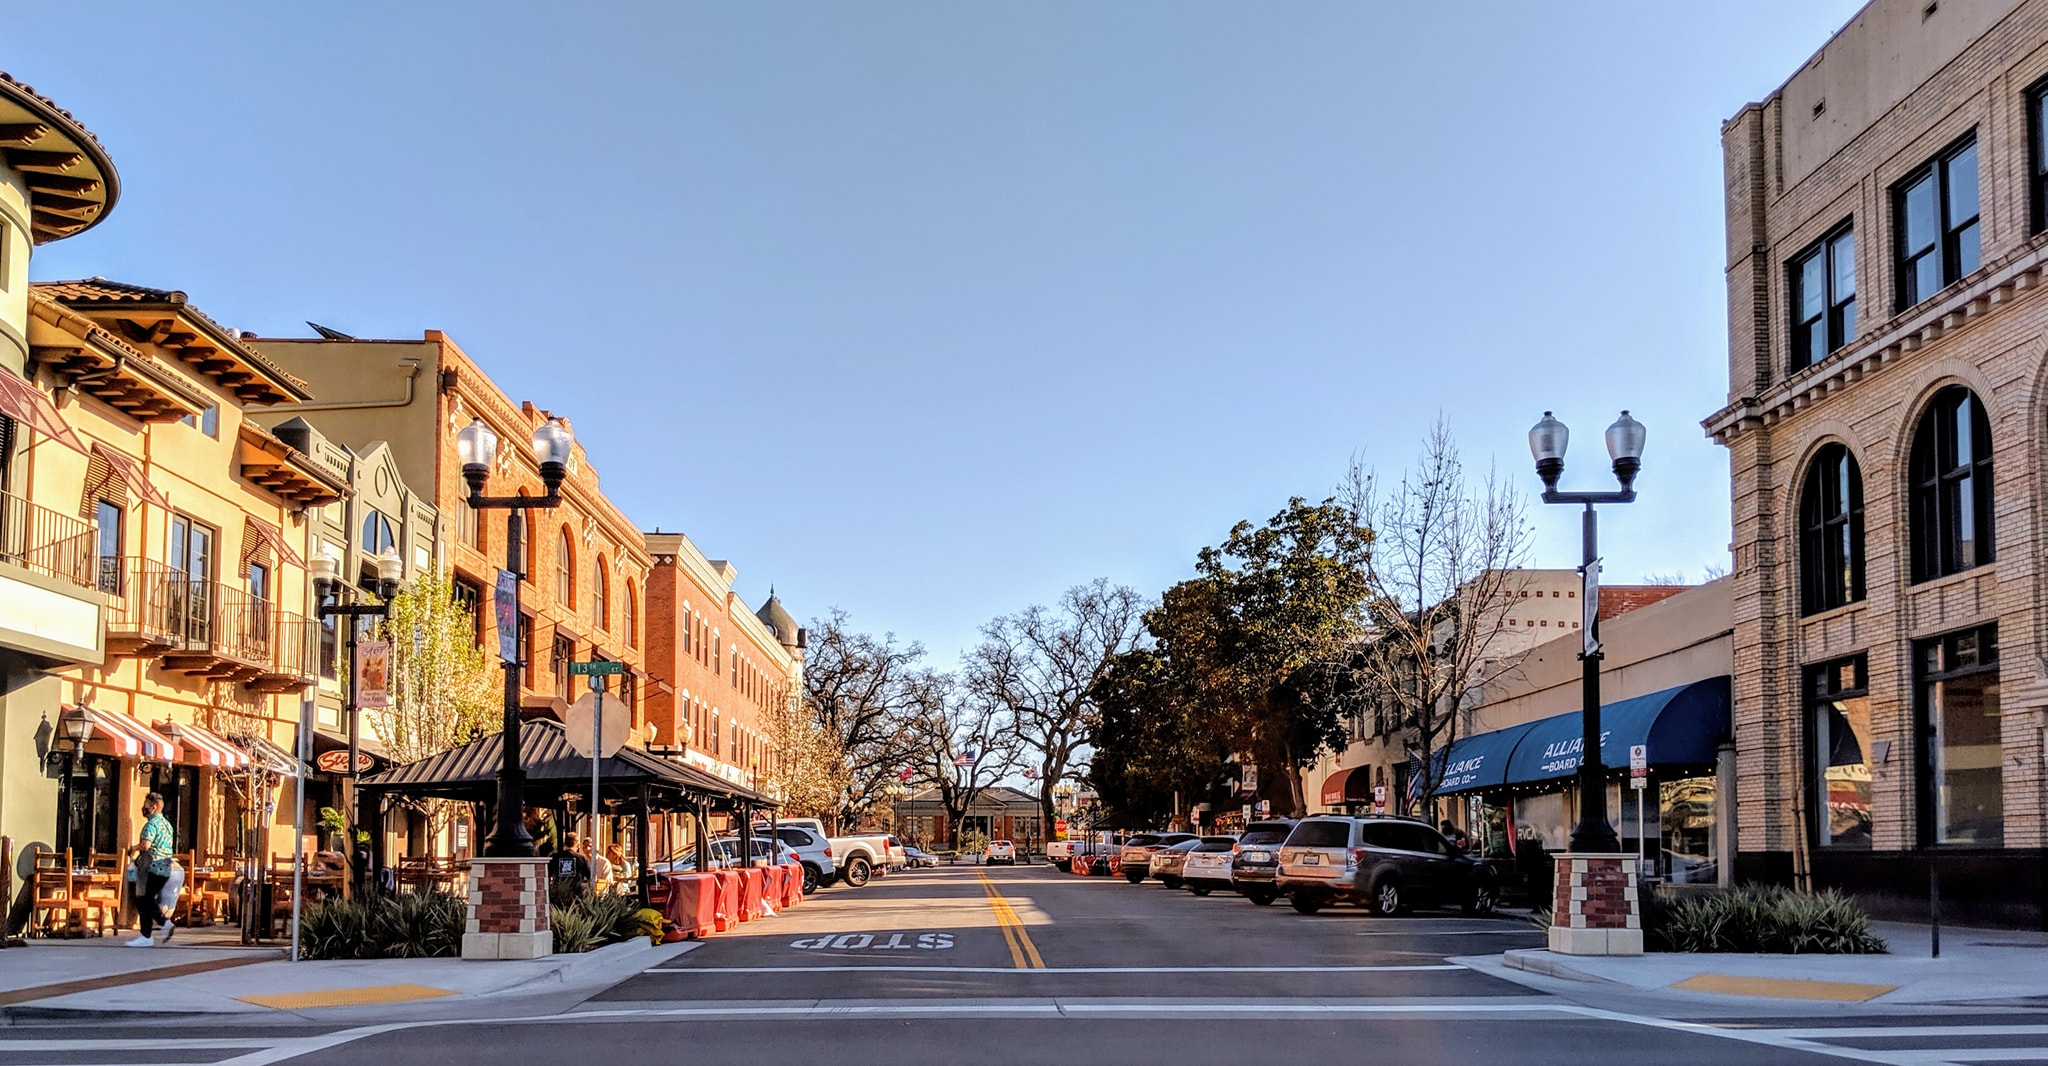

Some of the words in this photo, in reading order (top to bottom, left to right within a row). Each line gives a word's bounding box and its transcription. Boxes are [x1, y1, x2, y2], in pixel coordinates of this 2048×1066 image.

[1543, 731, 1611, 759] ALLIAE
[1443, 755, 1485, 777] LLIANCE
[1548, 757, 1577, 772] BOARD
[789, 933, 954, 950] STOP
